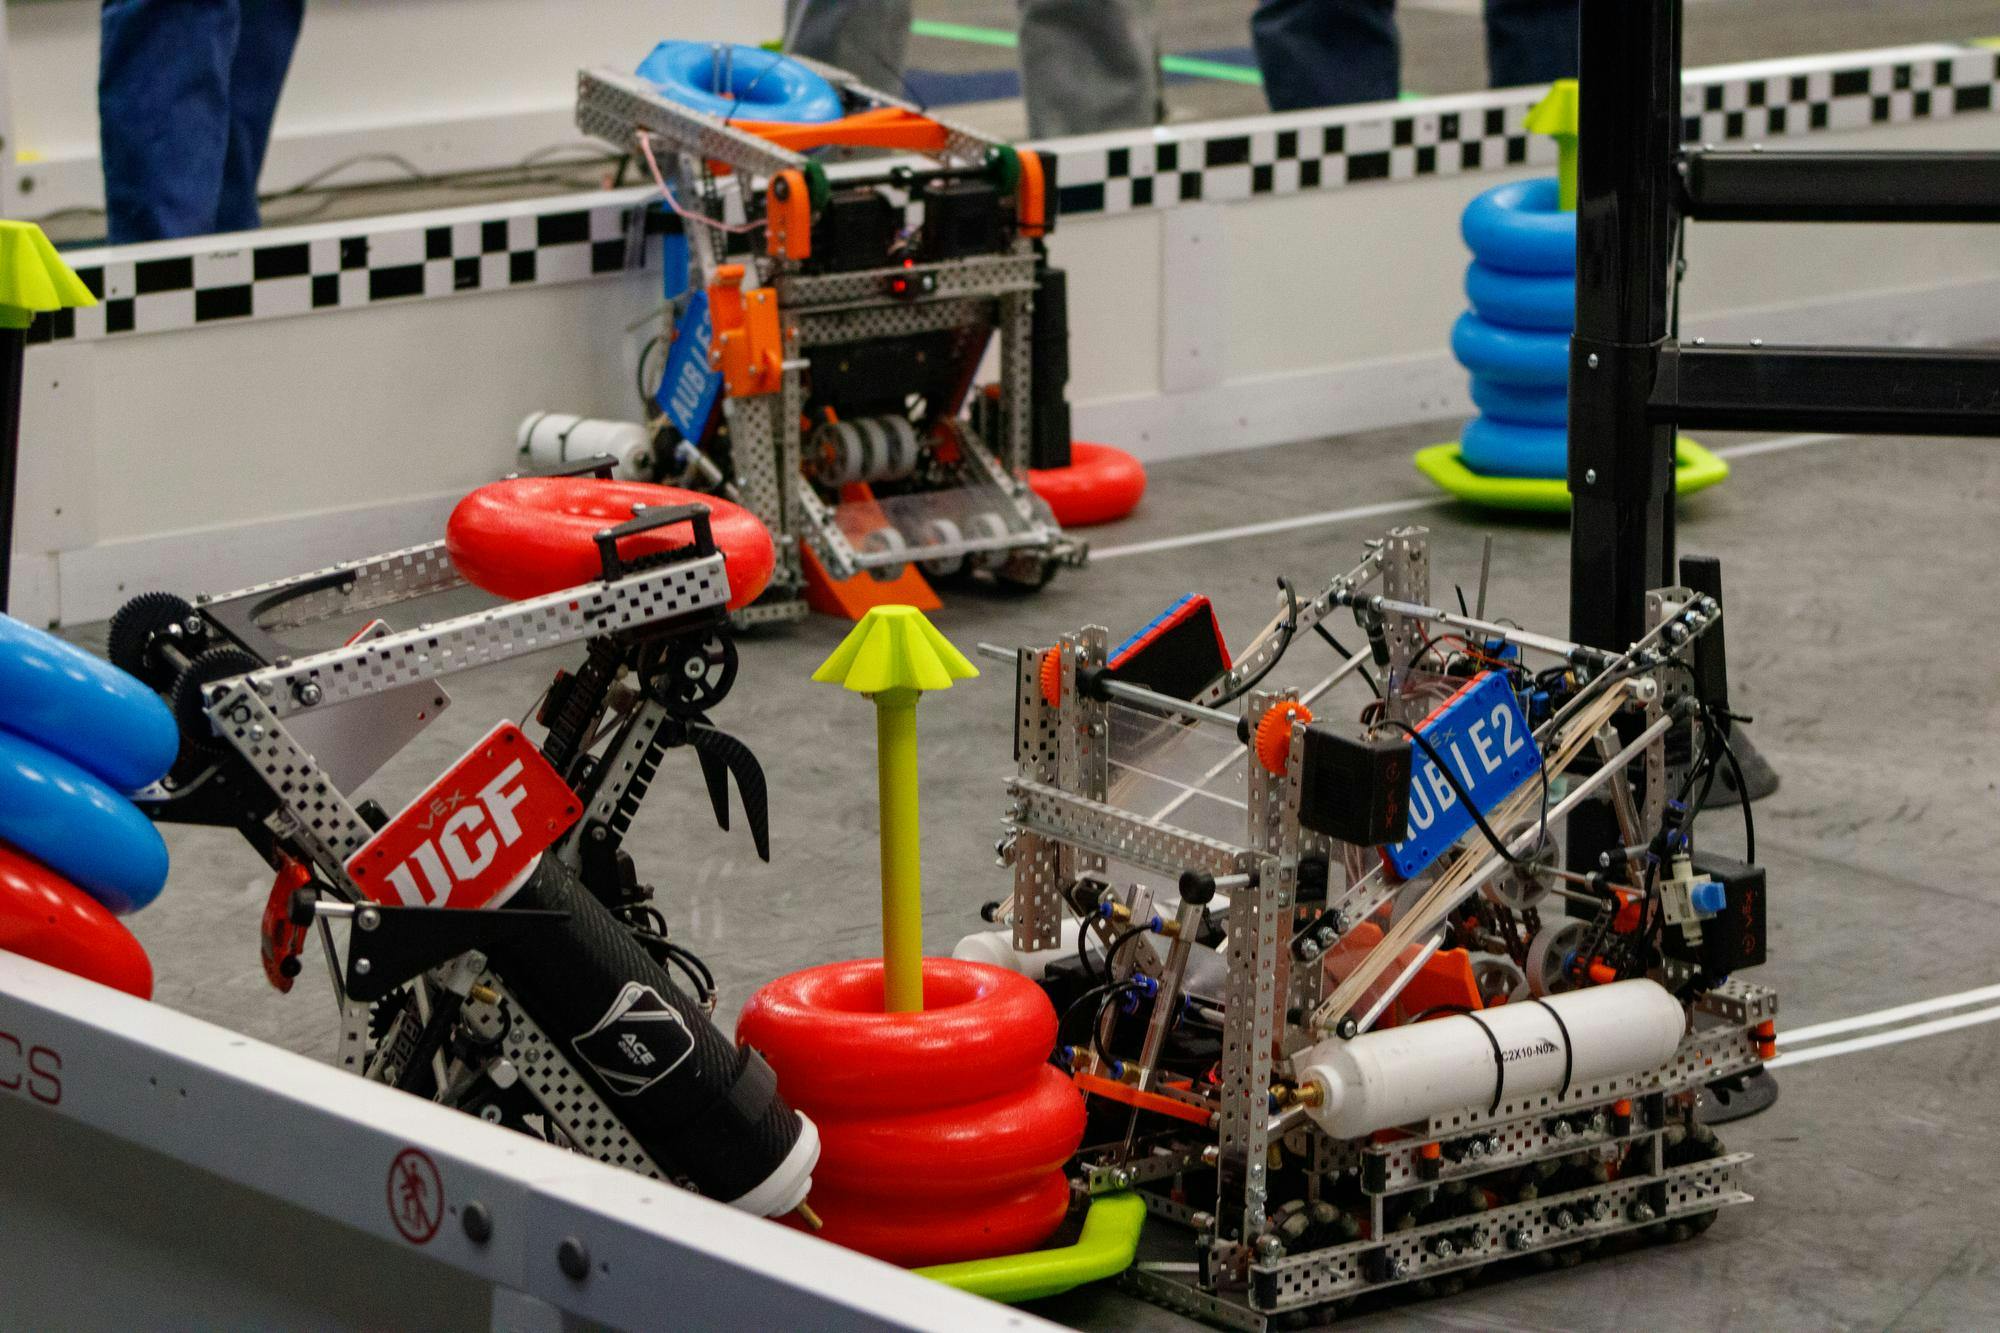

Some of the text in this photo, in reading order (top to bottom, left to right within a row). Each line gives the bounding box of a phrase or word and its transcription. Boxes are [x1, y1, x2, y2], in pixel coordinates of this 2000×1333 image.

[417, 789, 466, 830] VEX
[384, 758, 528, 909] UCF
[621, 1033, 656, 1066] ACE
